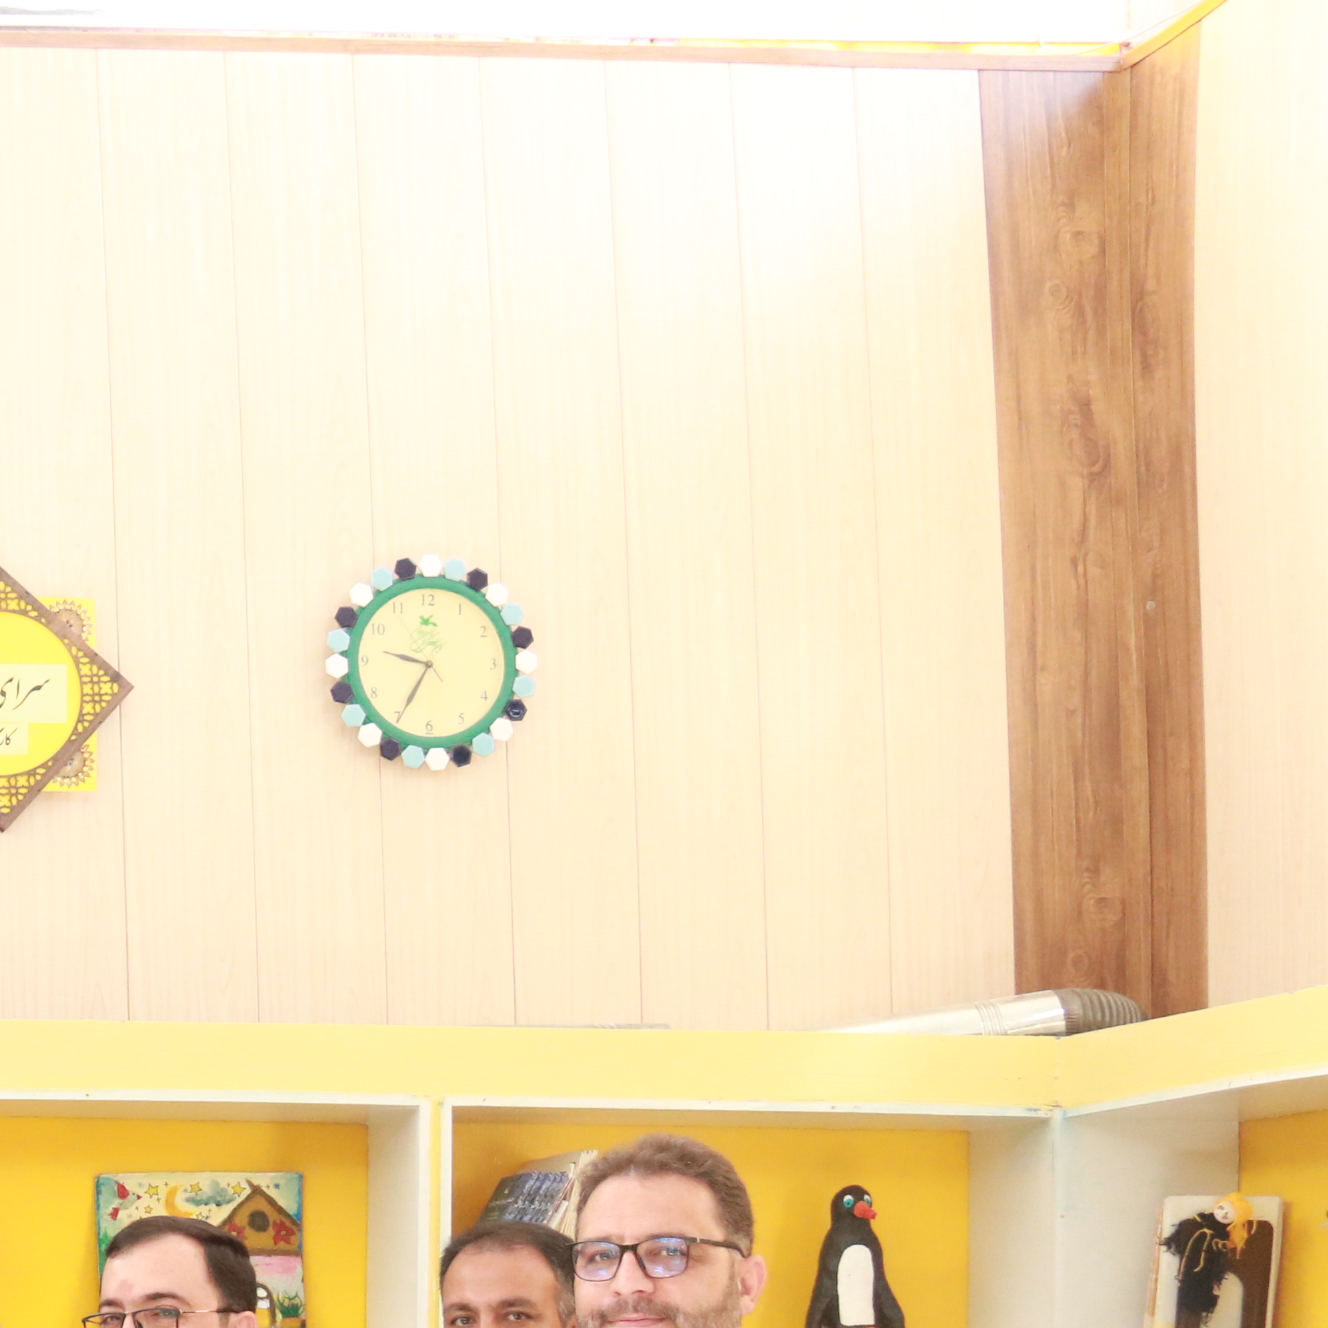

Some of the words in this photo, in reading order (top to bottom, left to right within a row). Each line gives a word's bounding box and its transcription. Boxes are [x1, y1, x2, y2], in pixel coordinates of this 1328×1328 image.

[420, 593, 435, 607] 12
[391, 601, 404, 614] 11
[457, 603, 463, 615] 1
[370, 623, 386, 636] 10
[479, 625, 487, 638] 2
[361, 654, 369, 667] 9
[489, 657, 497, 670] 3
[370, 687, 378, 699] 8
[480, 690, 489, 701] 4
[457, 712, 465, 725] 5
[425, 720, 434, 734] 6
